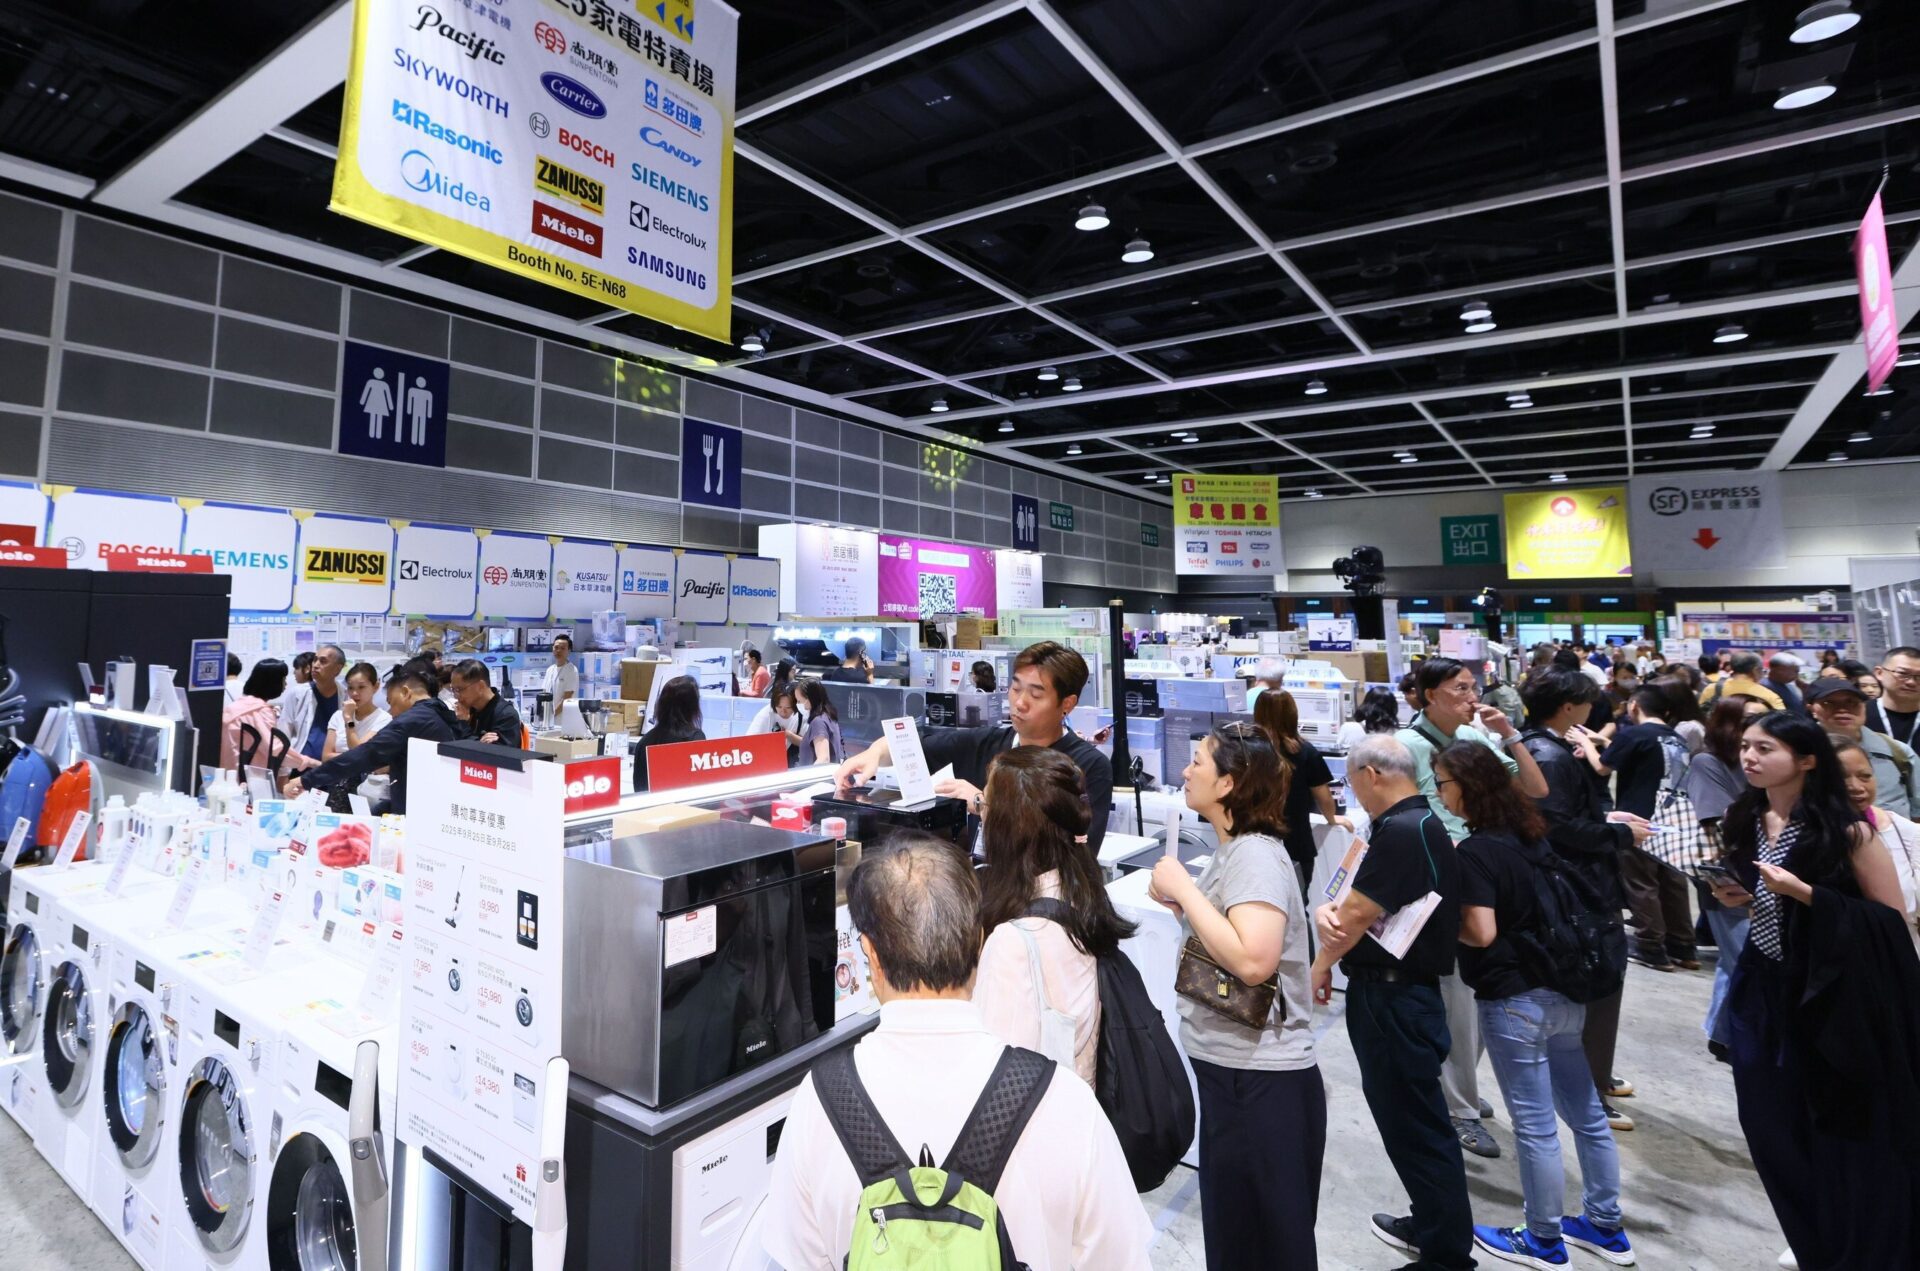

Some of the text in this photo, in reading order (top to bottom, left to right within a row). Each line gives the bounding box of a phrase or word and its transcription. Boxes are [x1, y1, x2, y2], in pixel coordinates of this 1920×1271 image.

[410, 5, 506, 66] Pacific
[394, 48, 509, 119] SKYWORTH
[570, 56, 619, 88] SUNPENTOWN
[551, 78, 600, 112] Carrier
[662, 96, 702, 132] 多田牌
[413, 109, 503, 165] Rasonic
[559, 128, 615, 168] BOSCH
[418, 165, 491, 212] Midea
[537, 160, 604, 206] ZANUSSI
[631, 162, 709, 212] SIEMENS
[541, 213, 596, 246] Miele
[652, 216, 707, 250] Electrolux
[508, 245, 627, 299] Booth No. 5E-N68
[628, 246, 707, 291] SAMSUNG
[1656, 486, 1760, 509] SF EXPRESS
[1450, 523, 1489, 539] EXIT
[1453, 540, 1488, 556] 出口
[137, 557, 187, 568] Miele
[307, 549, 385, 576] ZANUSSI
[422, 565, 473, 579] Electrolux
[576, 571, 609, 581] KUSATSU
[637, 577, 669, 593] 多田牌
[680, 578, 726, 599] Pacific
[741, 585, 777, 598] Rasonic
[464, 766, 493, 781] Miele
[690, 748, 753, 773] Miele
[564, 775, 611, 799] ele
[746, 1040, 767, 1054] Miele
[702, 1154, 729, 1174] Miele
